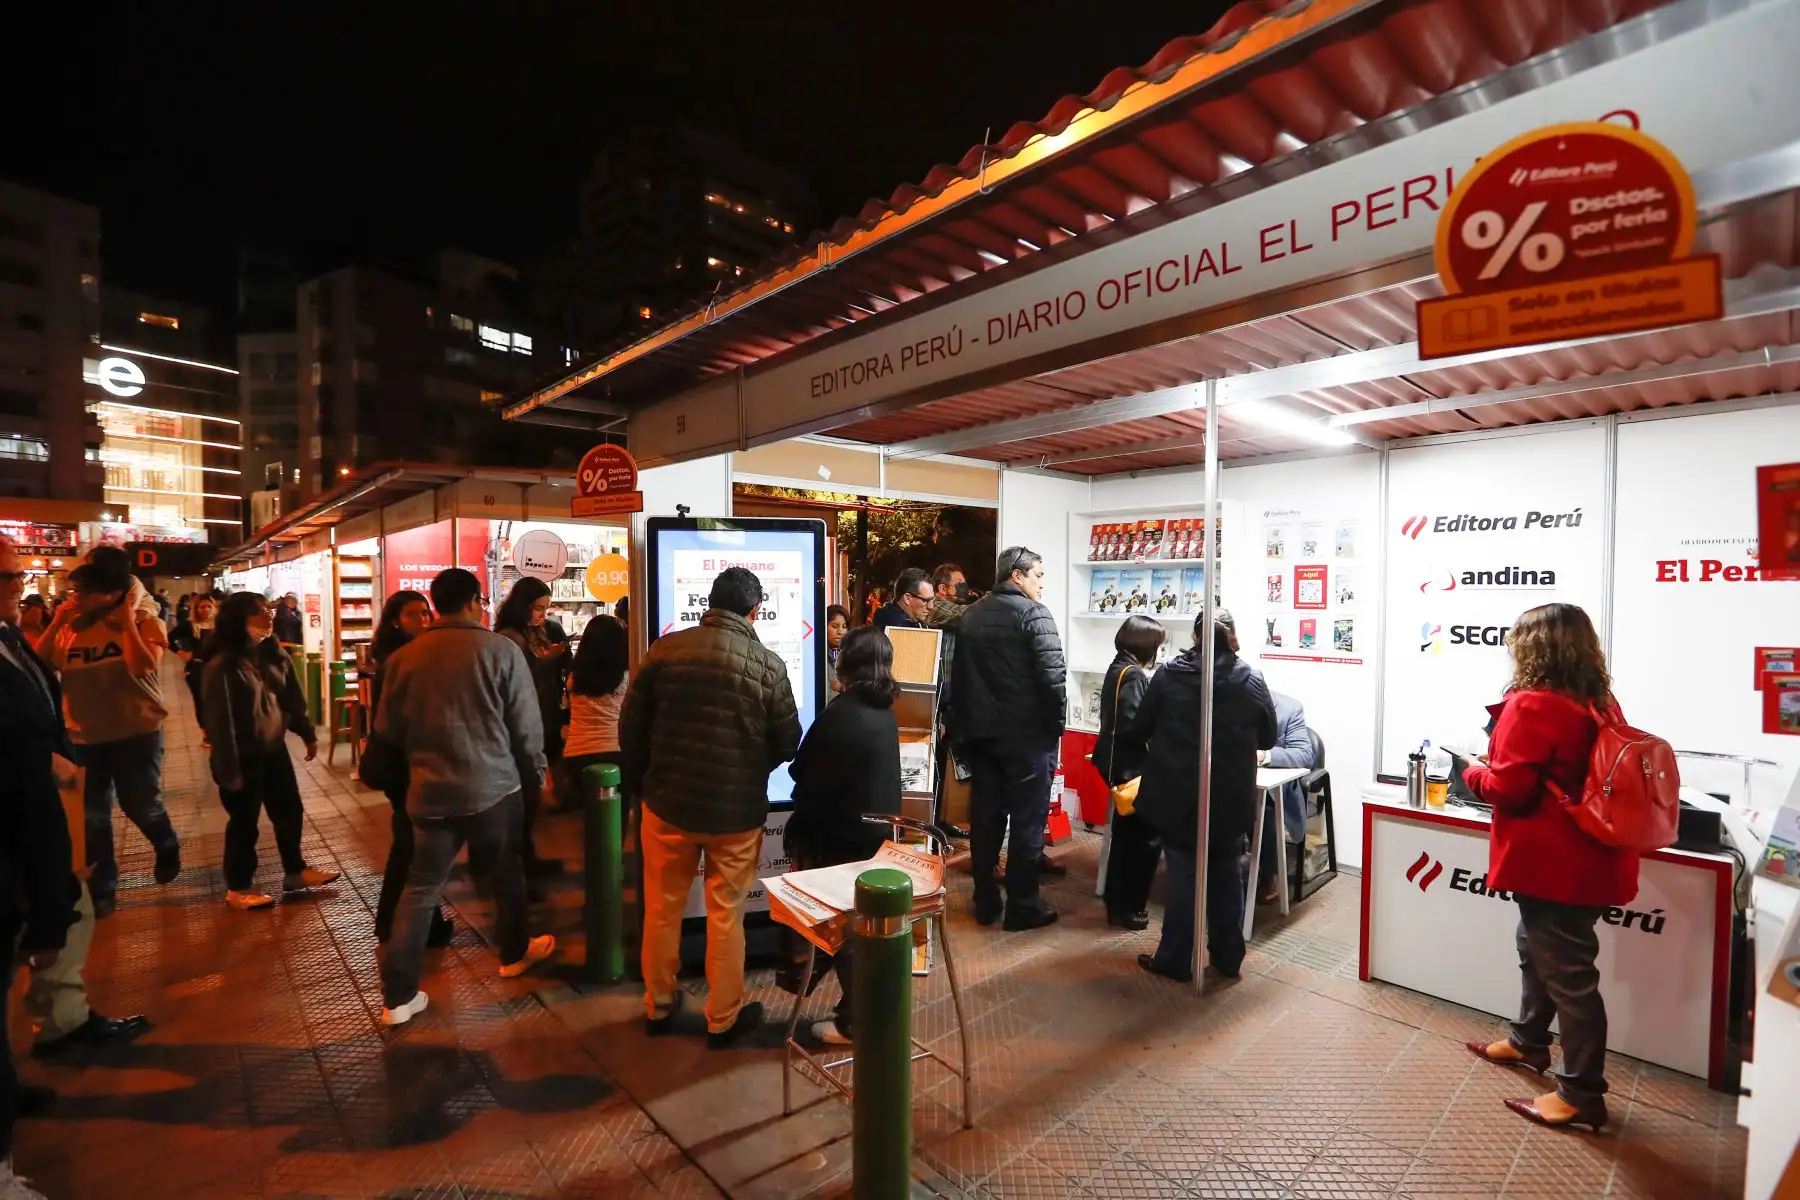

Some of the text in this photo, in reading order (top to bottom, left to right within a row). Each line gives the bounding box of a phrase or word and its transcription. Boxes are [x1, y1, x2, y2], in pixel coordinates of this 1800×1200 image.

[1571, 207, 1668, 240] por feria
[1461, 201, 1565, 280] %
[811, 353, 894, 398] EDITORA
[901, 325, 964, 371] PERÚ
[988, 290, 1085, 345] DIARIO
[1097, 242, 1242, 310] OFICIAL
[1260, 219, 1314, 263] EL
[676, 414, 686, 434] 59
[484, 495, 495, 506] 60
[1433, 507, 1583, 533] Editora Perú
[138, 550, 158, 567] D
[703, 559, 715, 571] El
[1461, 566, 1556, 585] andina
[1655, 559, 1760, 582] El Per
[762, 826, 784, 836] erú
[1601, 905, 1667, 934] erú
